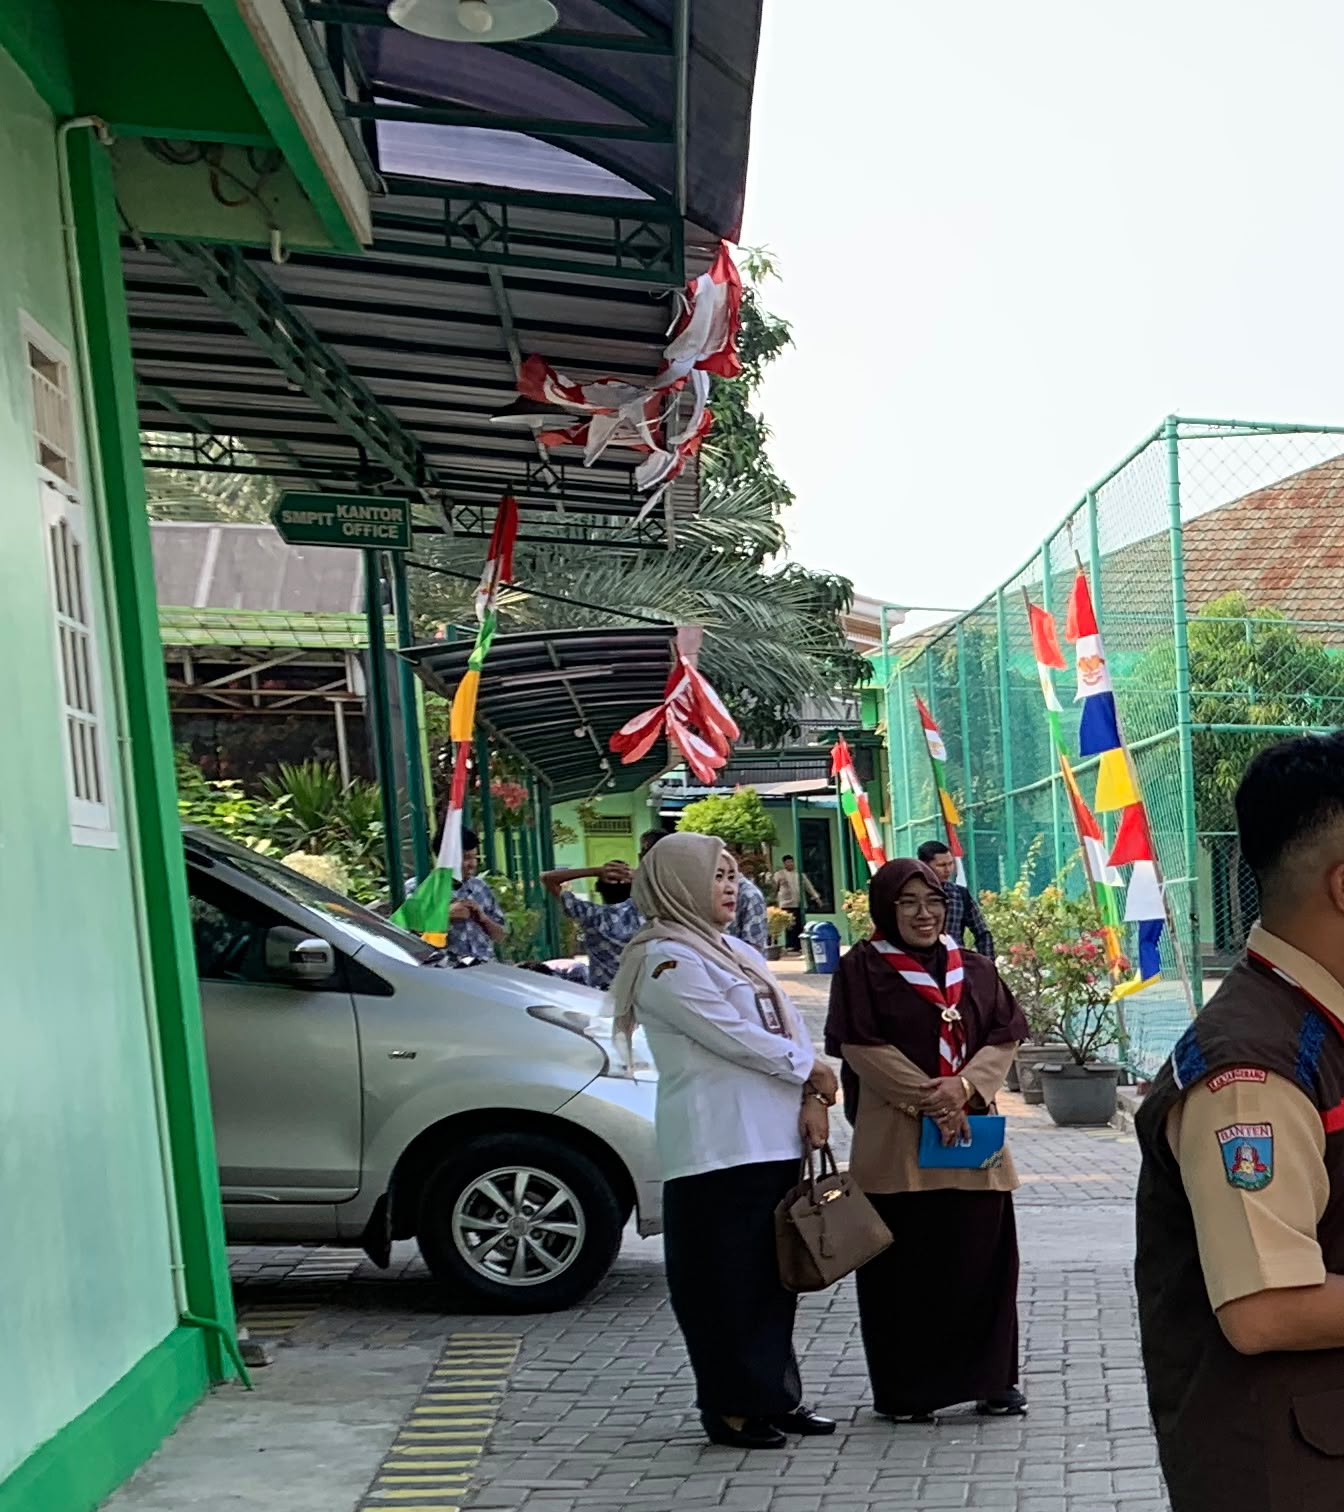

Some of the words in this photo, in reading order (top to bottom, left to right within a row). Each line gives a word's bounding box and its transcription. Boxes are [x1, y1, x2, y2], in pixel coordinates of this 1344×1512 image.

[281, 510, 334, 526] SMPIT
[336, 504, 403, 521] KANTOR
[342, 522, 399, 539] OFFICE
[1220, 1126, 1270, 1142] BANTEN
